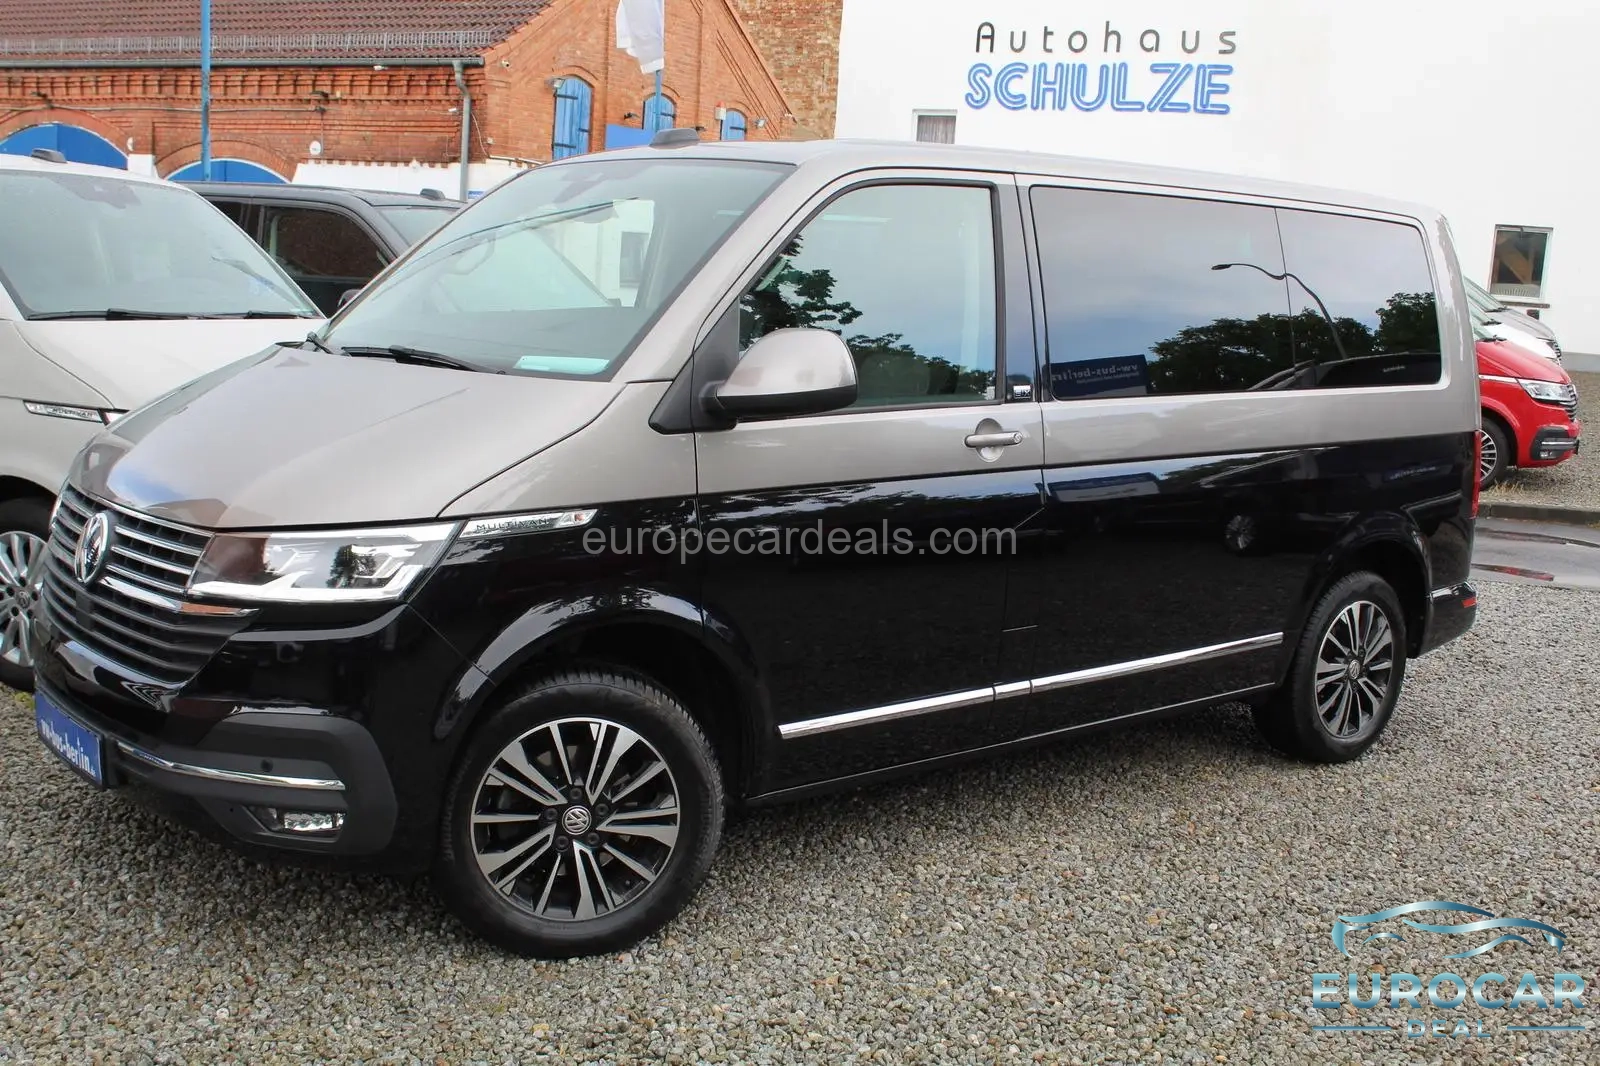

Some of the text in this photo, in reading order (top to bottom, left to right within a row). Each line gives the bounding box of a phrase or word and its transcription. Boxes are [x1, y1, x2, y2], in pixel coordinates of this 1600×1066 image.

[976, 21, 1236, 54] Autohaus
[965, 62, 1233, 115] SCHULZE
[476, 517, 550, 533] MULTIVAN
